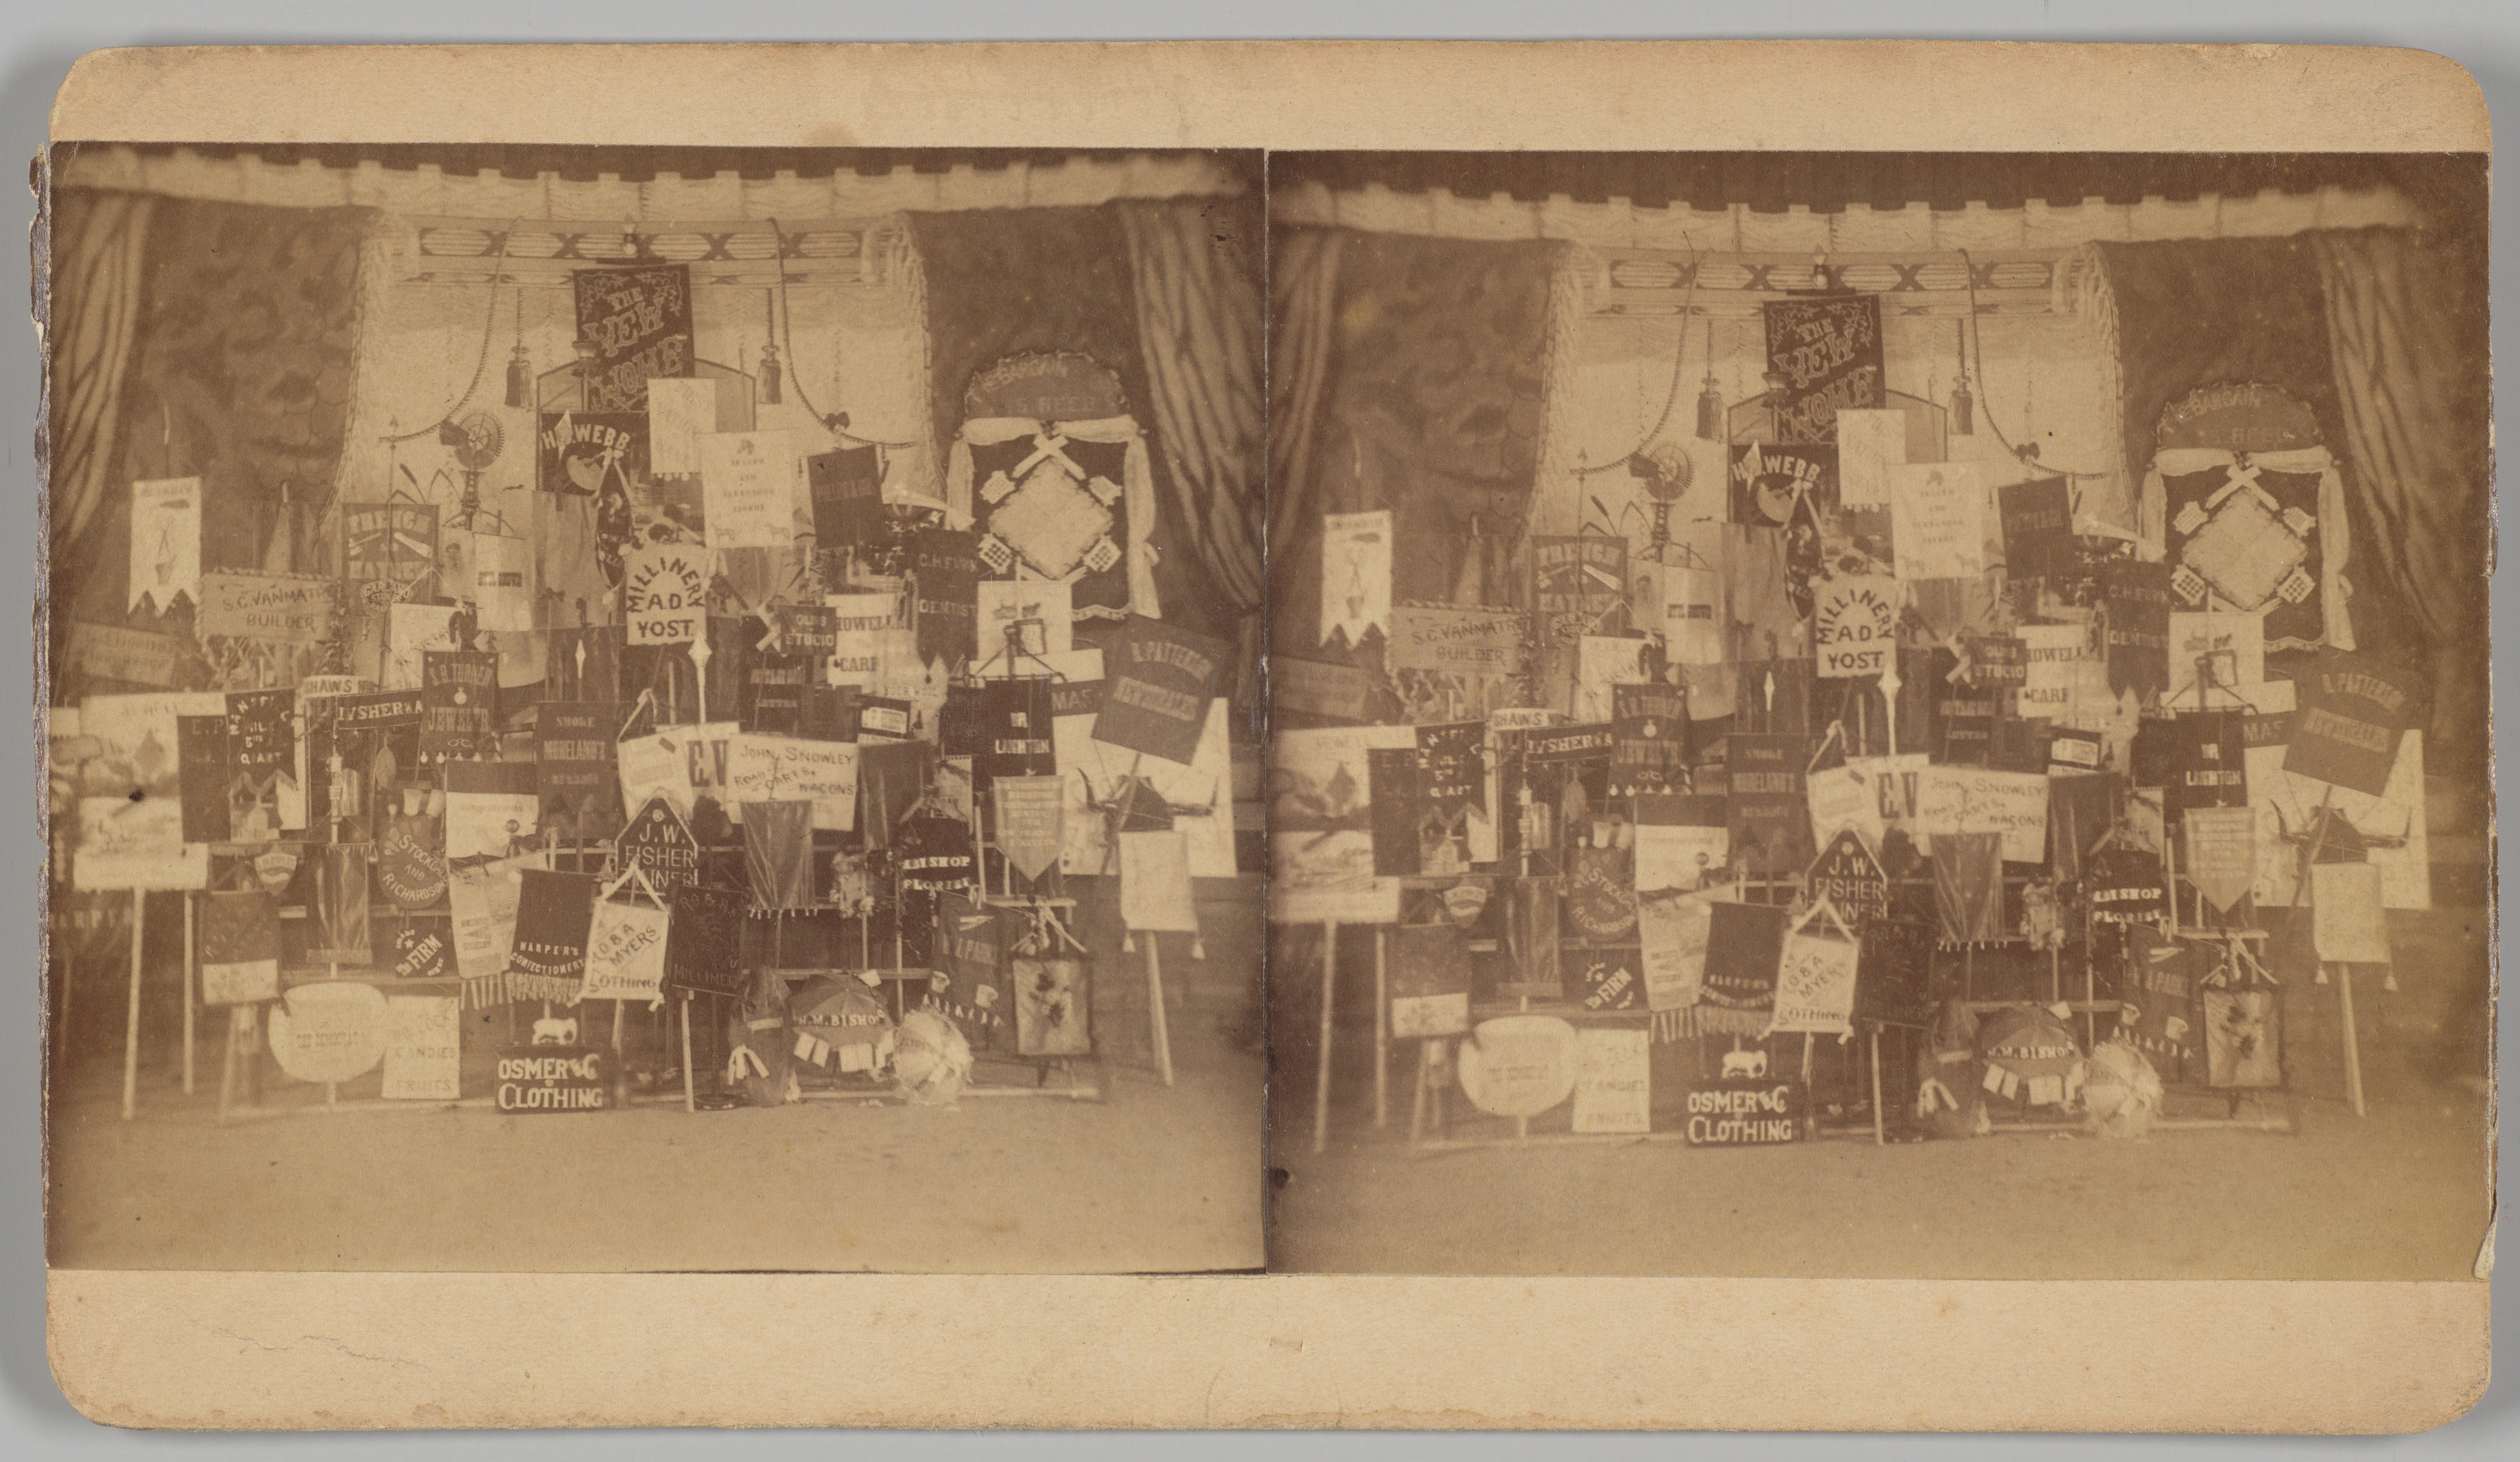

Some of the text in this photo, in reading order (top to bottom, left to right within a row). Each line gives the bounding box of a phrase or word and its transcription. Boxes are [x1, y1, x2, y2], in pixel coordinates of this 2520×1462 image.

[574, 424, 630, 450] WEBB
[1763, 455, 1822, 482] WEBB
[626, 557, 706, 613] MILLINERY
[246, 613, 316, 633] BUILDER
[637, 620, 694, 637] YOST
[1816, 588, 1895, 645] MILLINERY
[1827, 651, 1883, 671] YOST
[625, 845, 694, 868] FISHER
[1814, 877, 1883, 900] FISHER
[406, 933, 443, 971] FIRM
[520, 941, 579, 956] HARPER'S
[610, 925, 658, 966] MYERS
[498, 1057, 569, 1081] OSMER
[498, 1082, 603, 1110] CLOTHING
[1687, 1090, 1757, 1113] OSMER
[1687, 1115, 1792, 1143] CLOTHING
